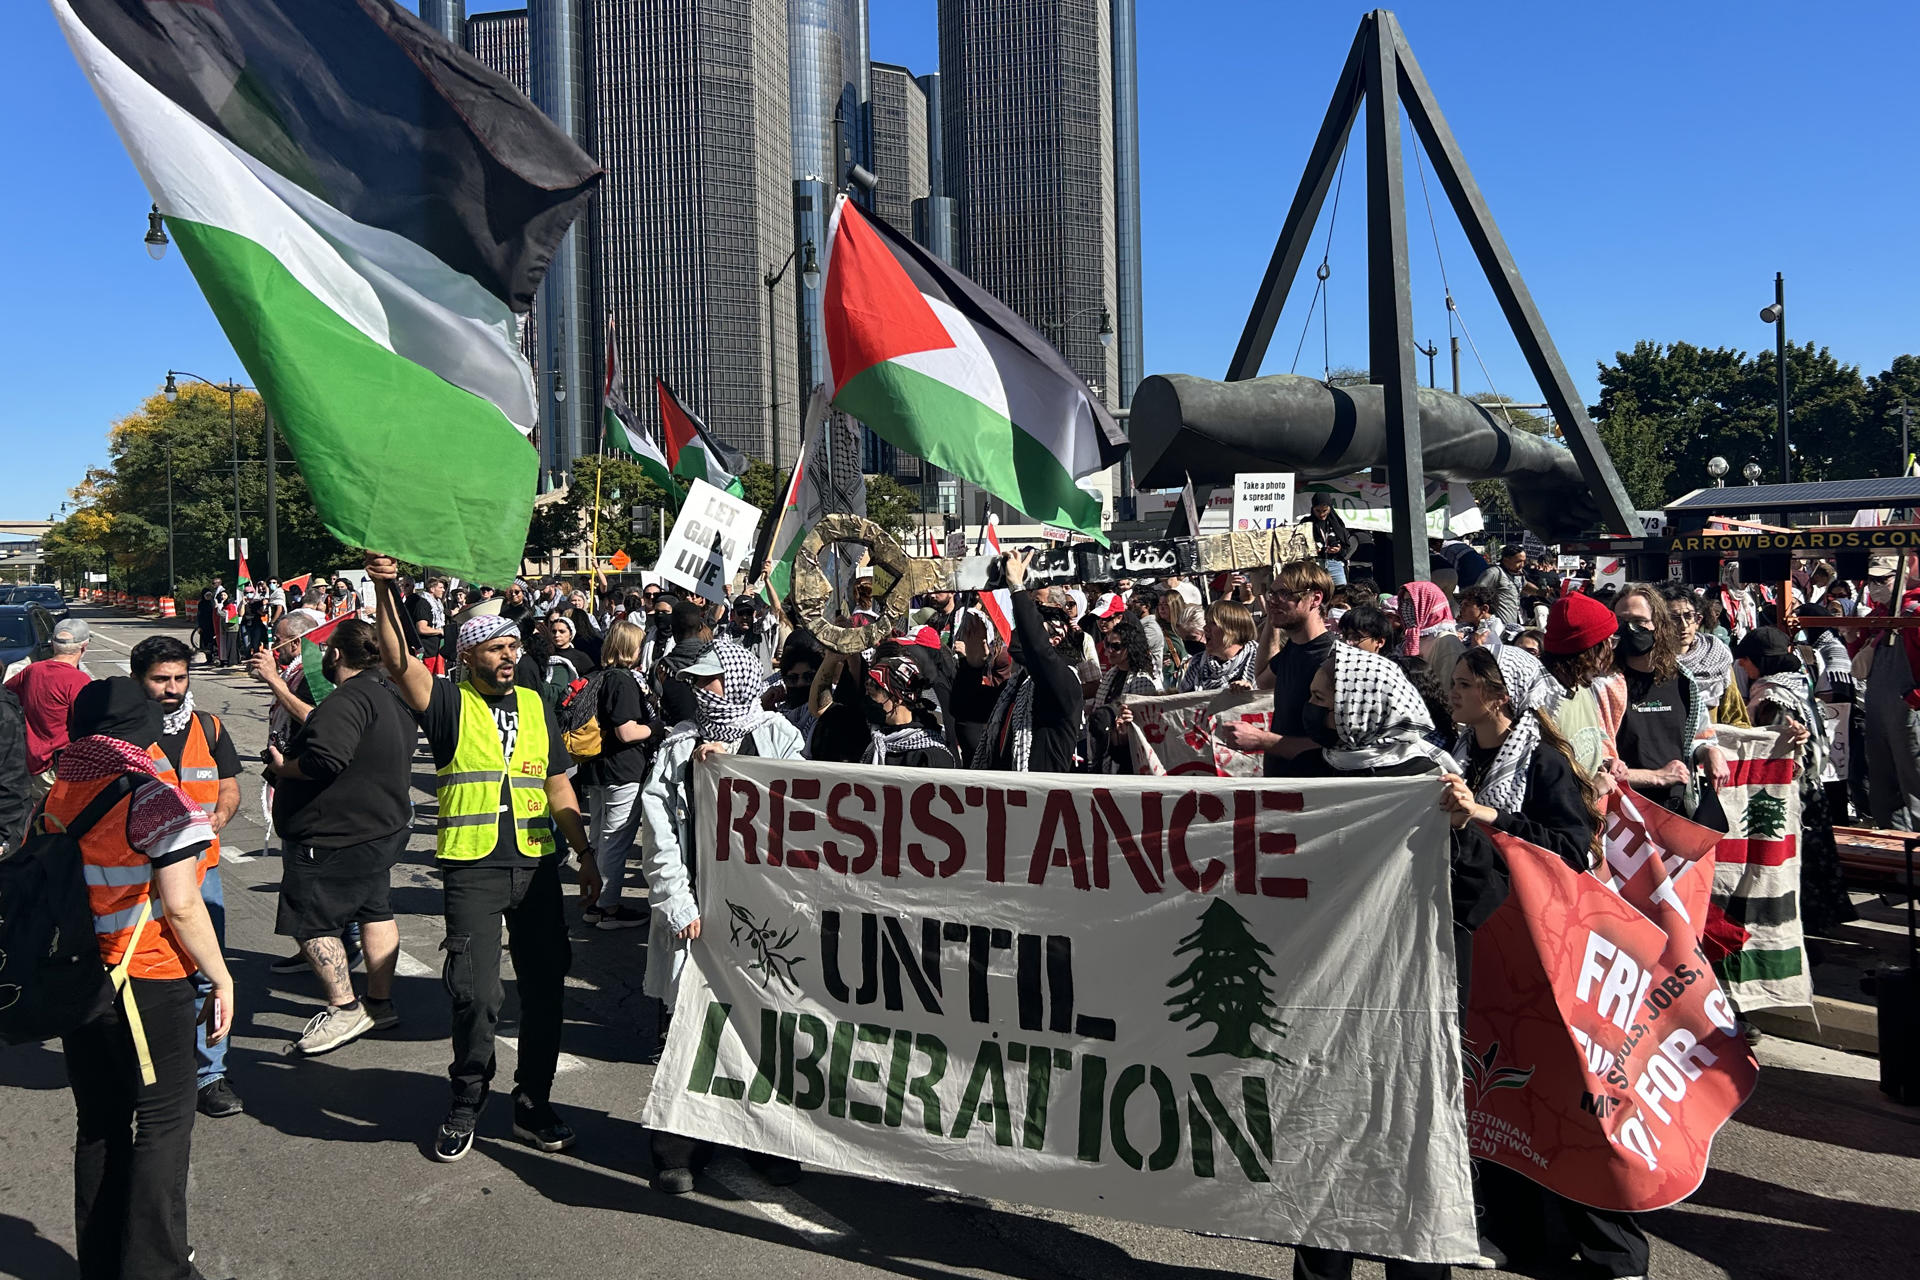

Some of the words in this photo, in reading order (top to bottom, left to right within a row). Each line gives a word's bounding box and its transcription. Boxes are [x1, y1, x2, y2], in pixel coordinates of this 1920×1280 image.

[1243, 481, 1259, 490] Take
[1266, 482, 1286, 490] photo
[1249, 493, 1273, 502] spread
[1274, 493, 1286, 501] the
[704, 496, 740, 528] LET
[1254, 504, 1274, 512] word!
[683, 519, 737, 561] GAZA
[674, 548, 721, 587] LIVE
[521, 761, 543, 776] End
[714, 776, 1309, 899] RESISTANCE
[819, 910, 1117, 1043] UNTIL
[1643, 962, 1705, 1021] JOBS,
[686, 1002, 1274, 1184] LIBERATION
[1634, 1027, 1720, 1126] FOR
[1483, 1126, 1549, 1170] NETWORK
